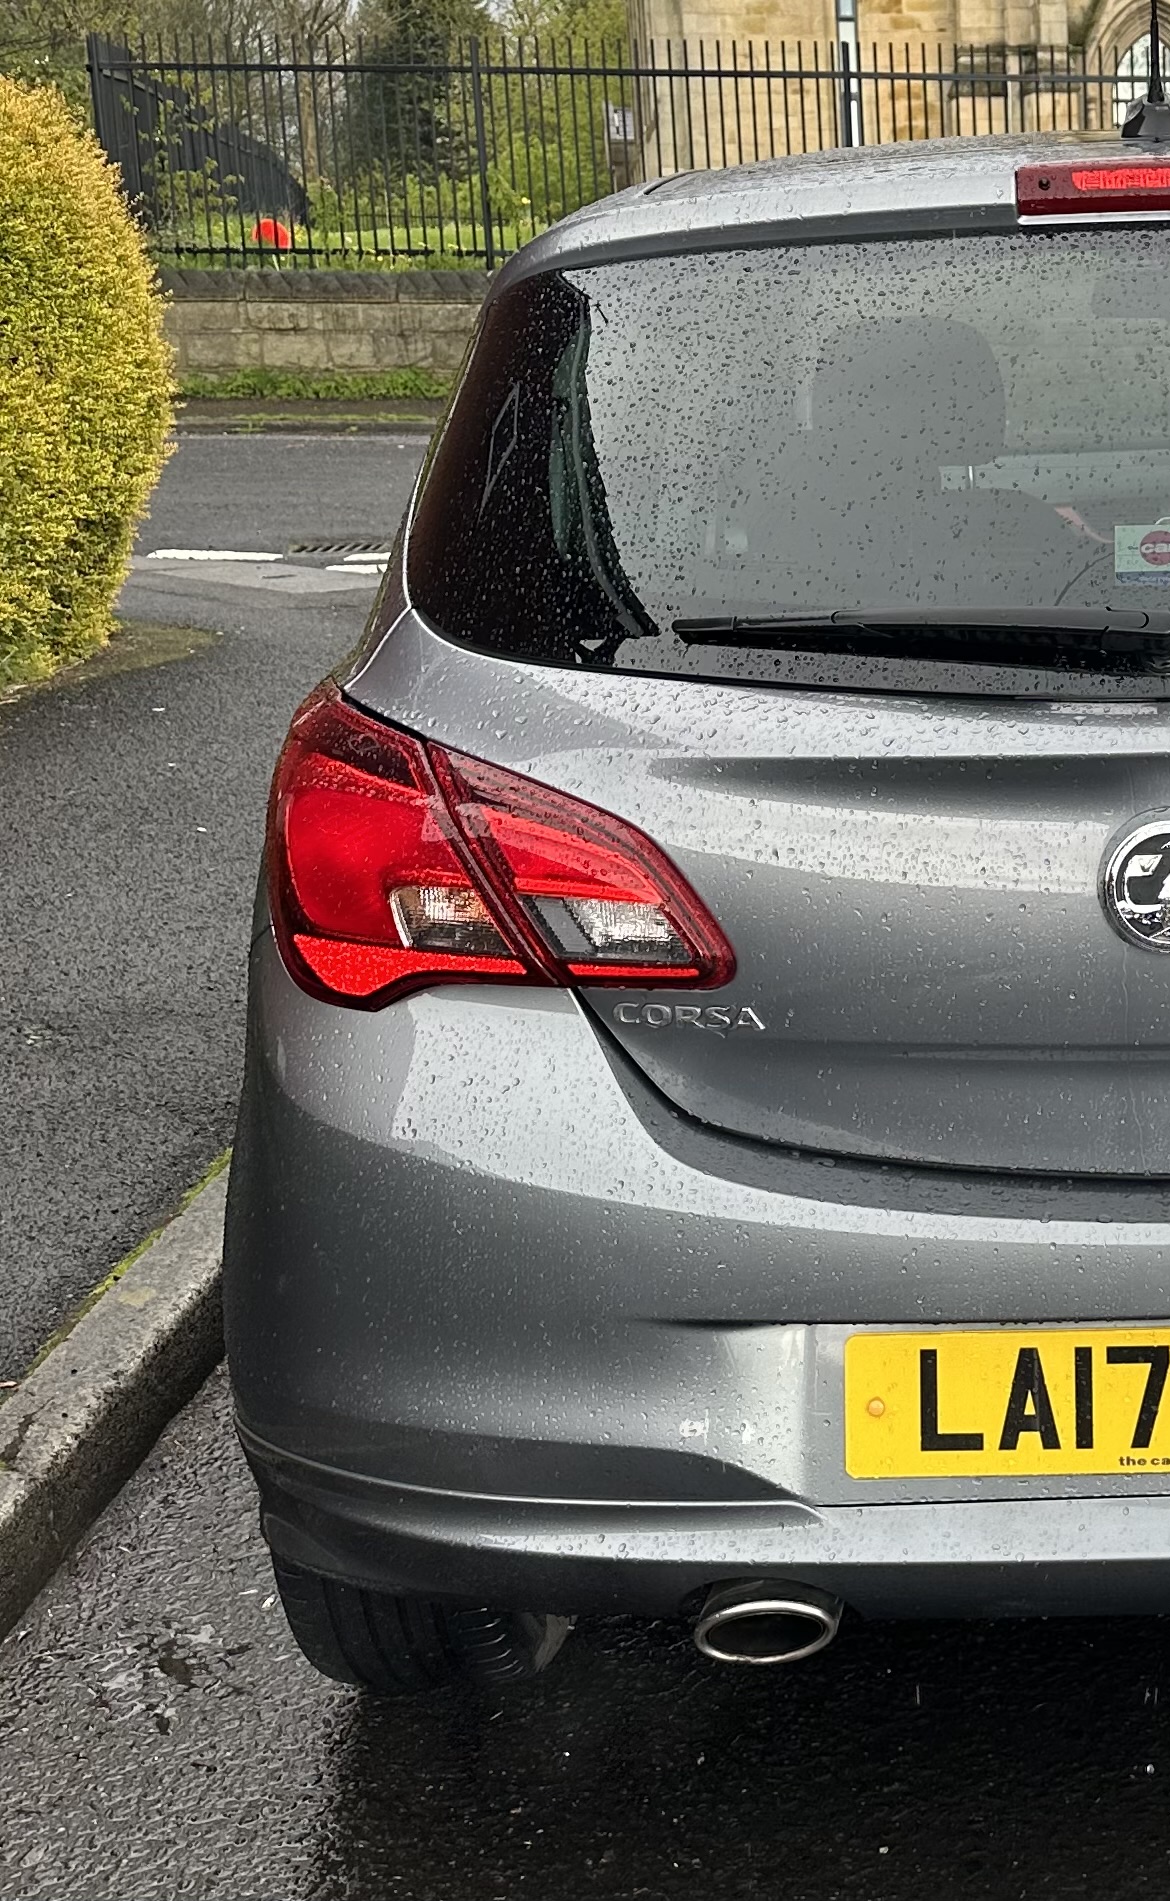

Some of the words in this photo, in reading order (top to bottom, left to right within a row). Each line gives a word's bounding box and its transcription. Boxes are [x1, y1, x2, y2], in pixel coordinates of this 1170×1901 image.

[612, 1002, 766, 1031] CORSA
[919, 1345, 1170, 1451] LA17
[1119, 1456, 1147, 1466] the
